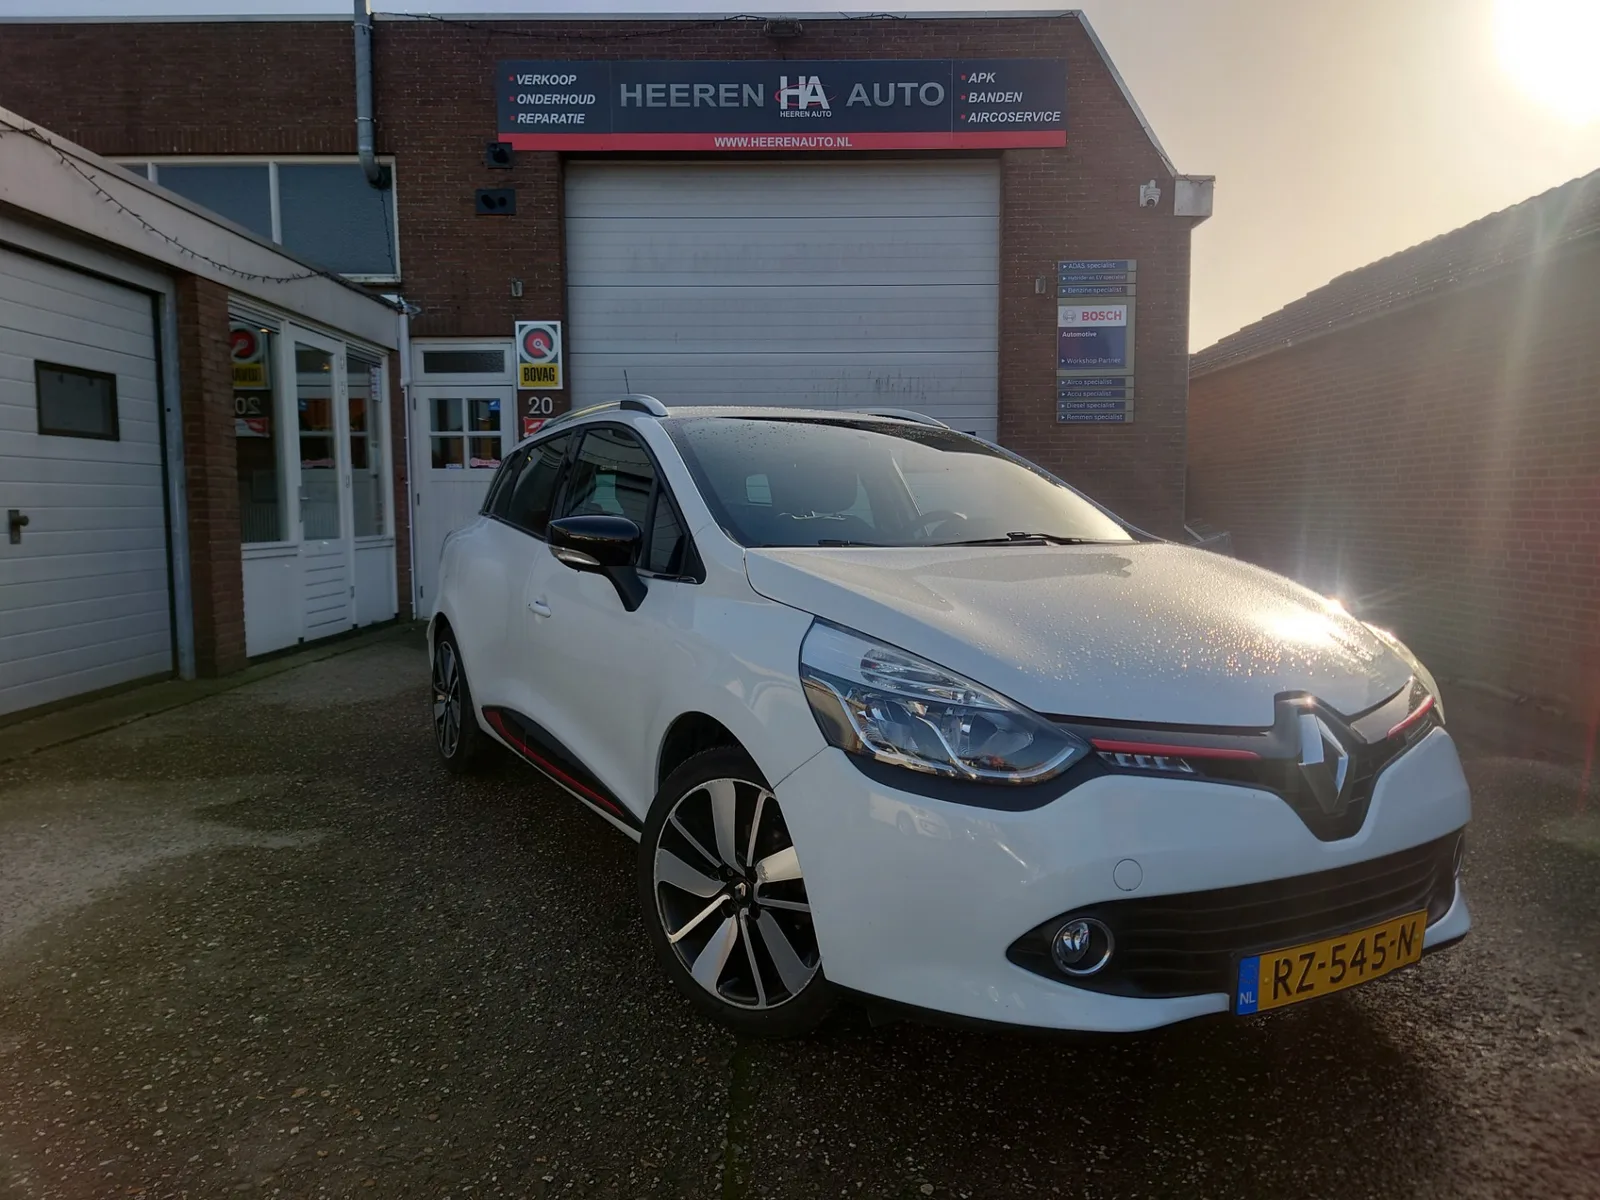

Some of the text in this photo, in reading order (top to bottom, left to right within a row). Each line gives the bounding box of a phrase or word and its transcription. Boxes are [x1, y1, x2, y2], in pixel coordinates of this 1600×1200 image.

[516, 74, 577, 85] VERKOOP
[968, 72, 996, 84] APK
[620, 82, 945, 107] HEEREN AUTO
[780, 75, 830, 109] HA
[968, 92, 1023, 103] BANDEN
[517, 94, 596, 105] ONDERHOUD
[517, 113, 585, 124] REPARATIE
[780, 110, 832, 118] HEEREN AUTO
[968, 111, 1061, 123] AIRCOSERVICE
[714, 136, 852, 147] WWW.HEERENAUTO.NL
[1087, 262, 1116, 270] specialist
[1093, 287, 1122, 295] specialist
[1081, 310, 1122, 321] BOSCH
[523, 367, 555, 382] BOVAG
[528, 396, 553, 414] 20
[1273, 921, 1417, 1000] RZ-545-N
[1239, 991, 1256, 1005] NL
